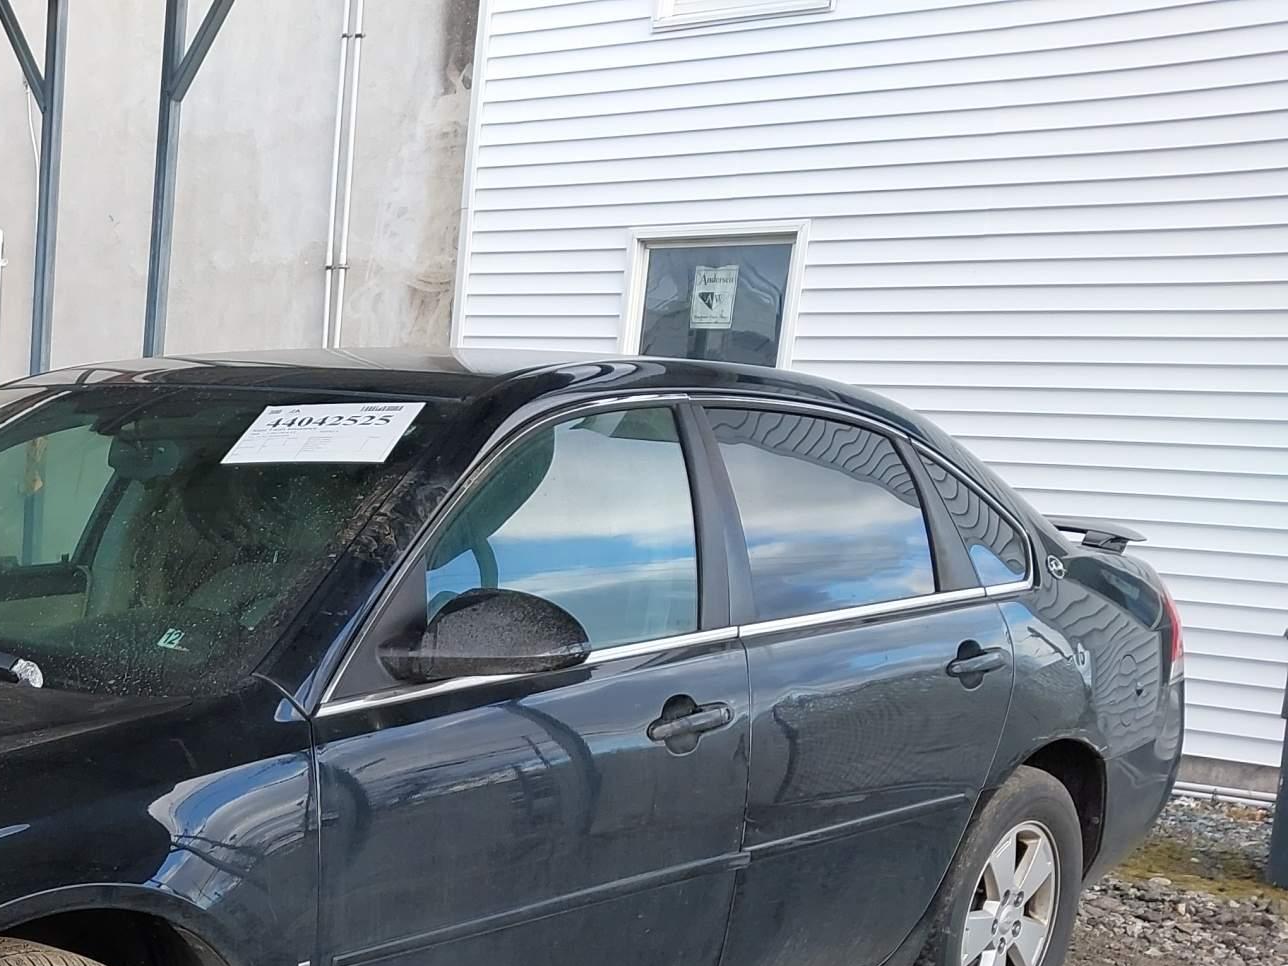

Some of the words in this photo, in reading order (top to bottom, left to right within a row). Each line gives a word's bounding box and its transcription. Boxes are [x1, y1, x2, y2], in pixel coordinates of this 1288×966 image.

[699, 272, 734, 286] Andersen
[266, 414, 394, 428] 44042525
[162, 630, 183, 645] 12
